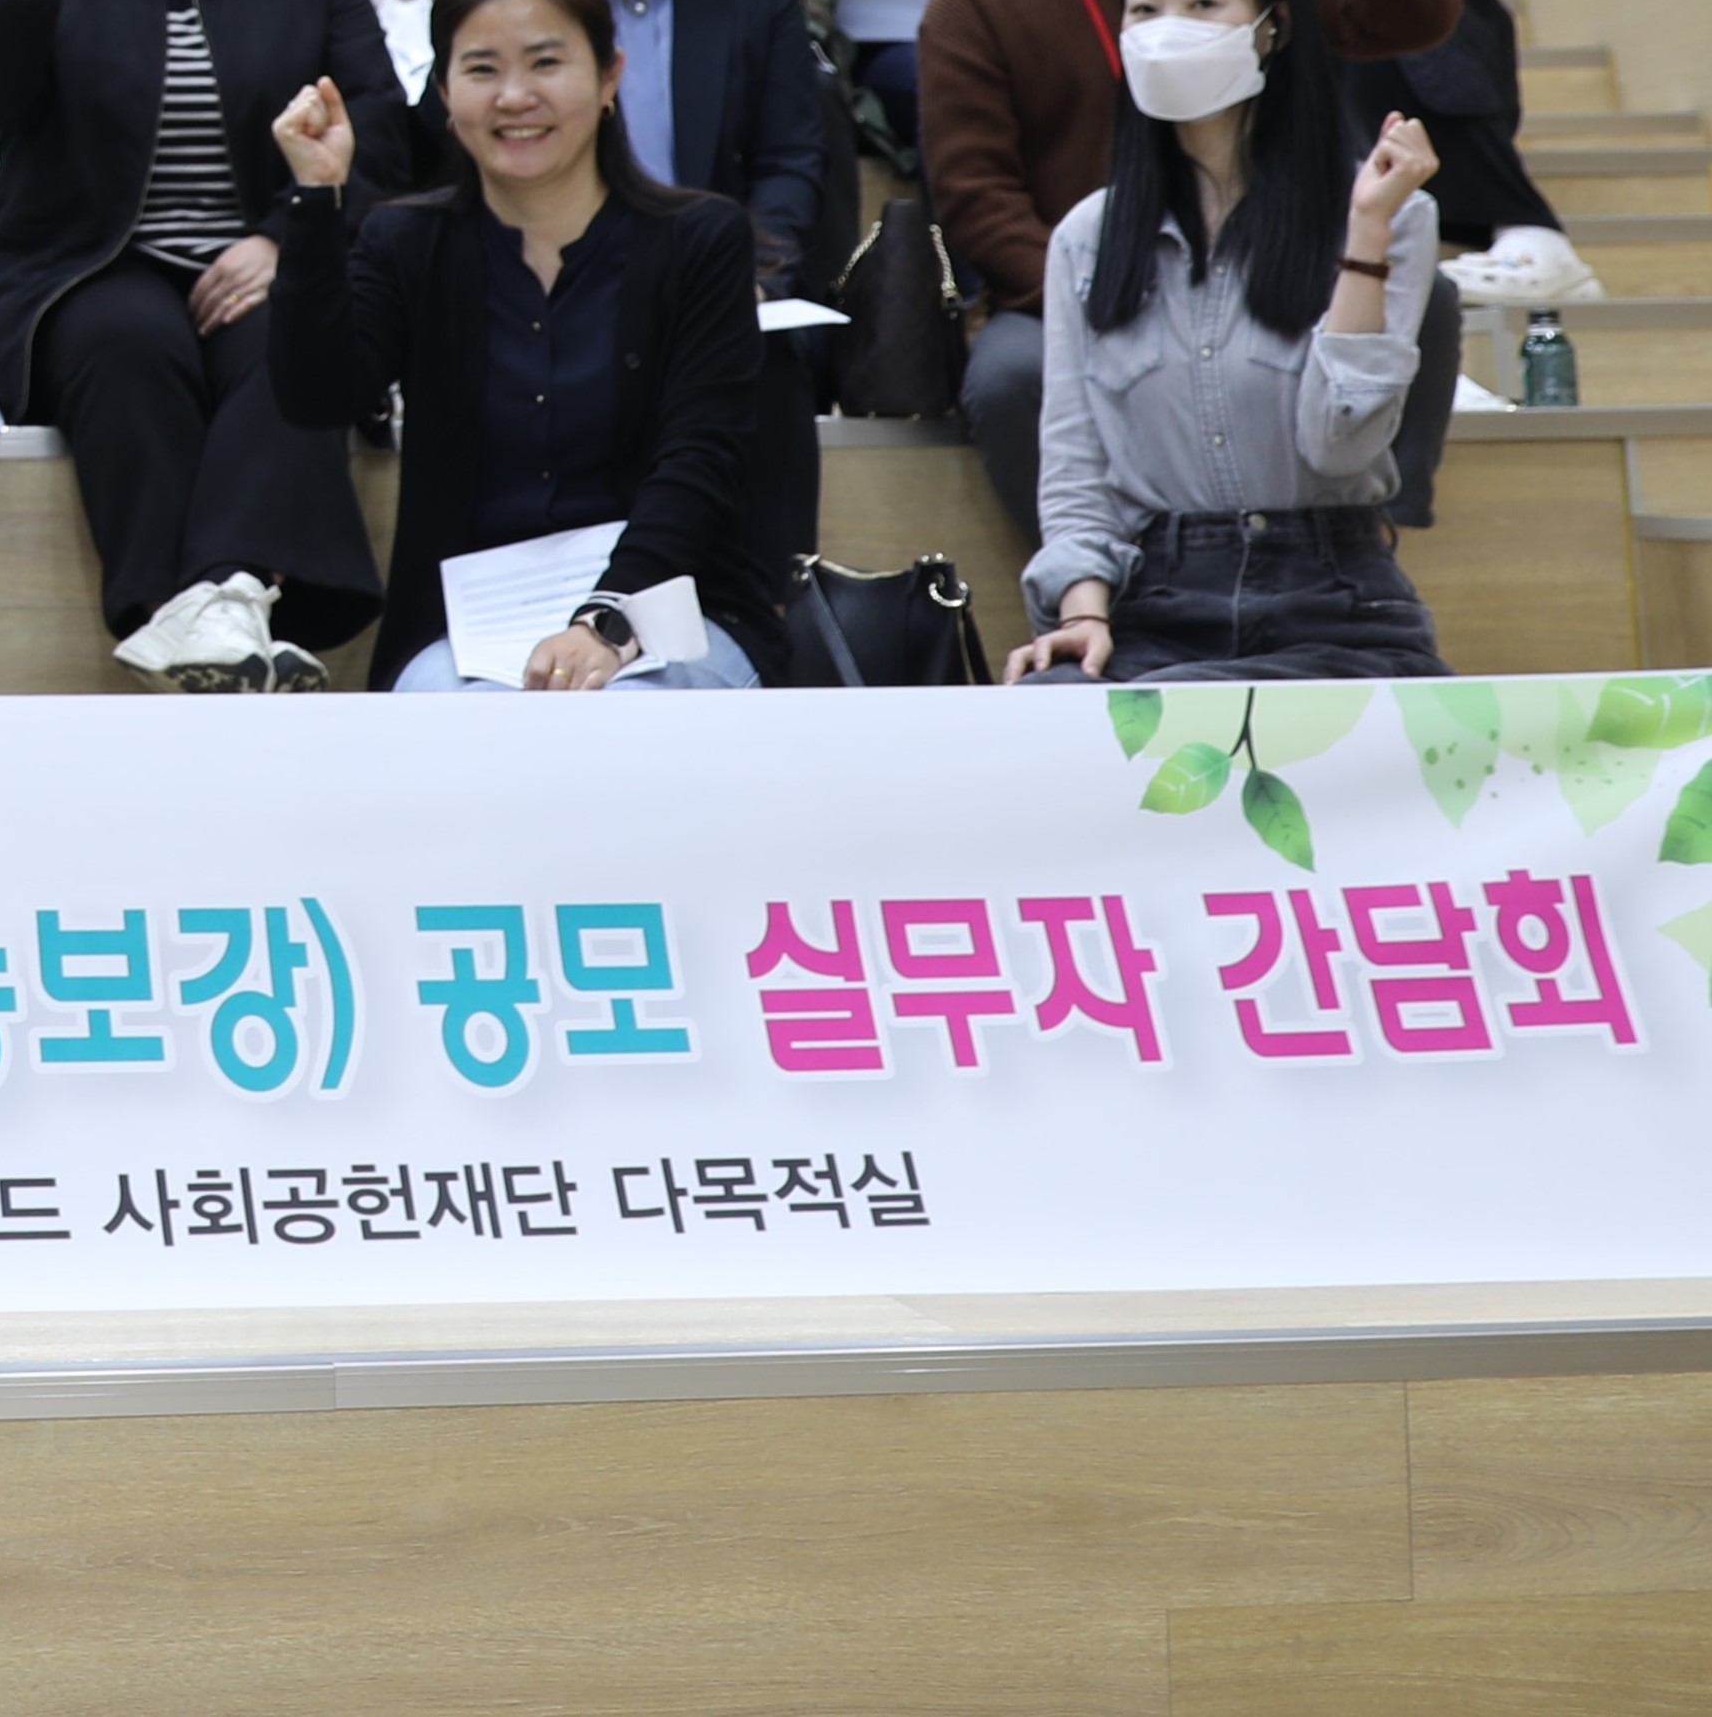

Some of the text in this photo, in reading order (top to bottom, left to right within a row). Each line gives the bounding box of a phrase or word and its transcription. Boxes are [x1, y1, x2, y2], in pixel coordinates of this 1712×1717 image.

[414, 901, 691, 1089] 공모
[744, 894, 1165, 1073] 실무자
[1201, 868, 1640, 1059] 간담회
[102, 1159, 579, 1248] 사회공헌재단
[611, 1150, 931, 1235] 다목적실
